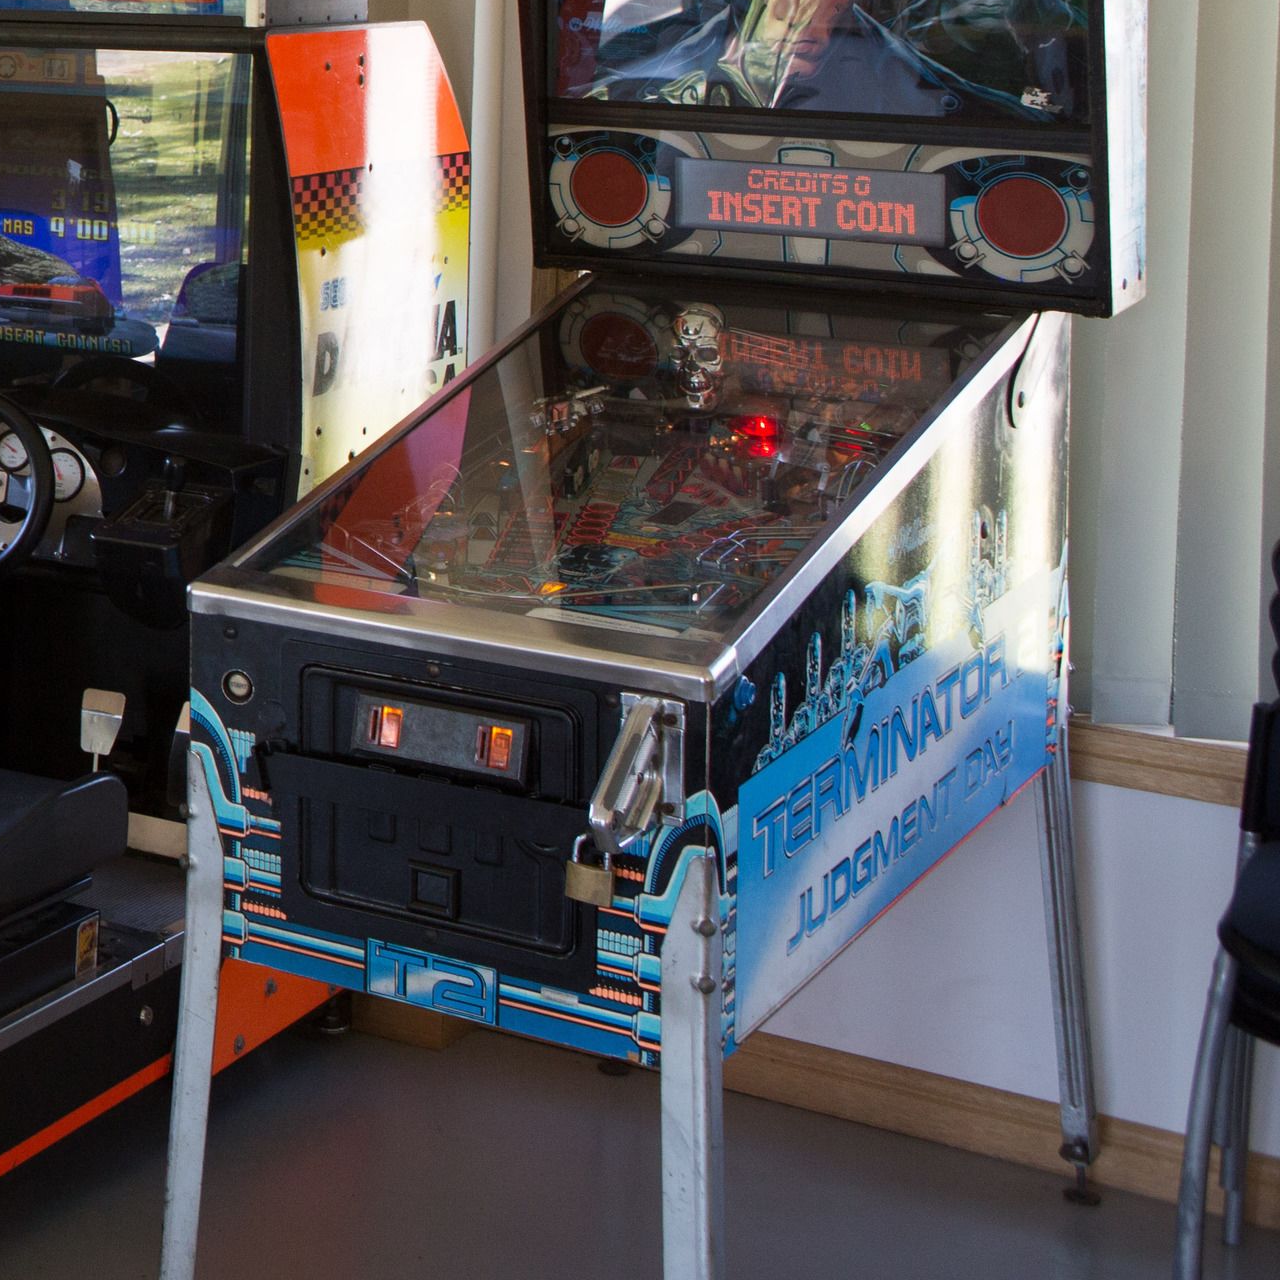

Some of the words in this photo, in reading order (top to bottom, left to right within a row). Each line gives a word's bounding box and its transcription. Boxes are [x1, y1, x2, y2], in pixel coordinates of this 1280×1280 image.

[747, 169, 849, 196] CREDITS
[3, 218, 35, 236] MAS
[707, 190, 822, 228] INSERT
[836, 199, 916, 236] COIN
[752, 634, 1008, 879] TERMINATOR
[786, 765, 958, 956] JUDGMENT
[964, 720, 1015, 803] DAY
[375, 945, 487, 1019] T2
